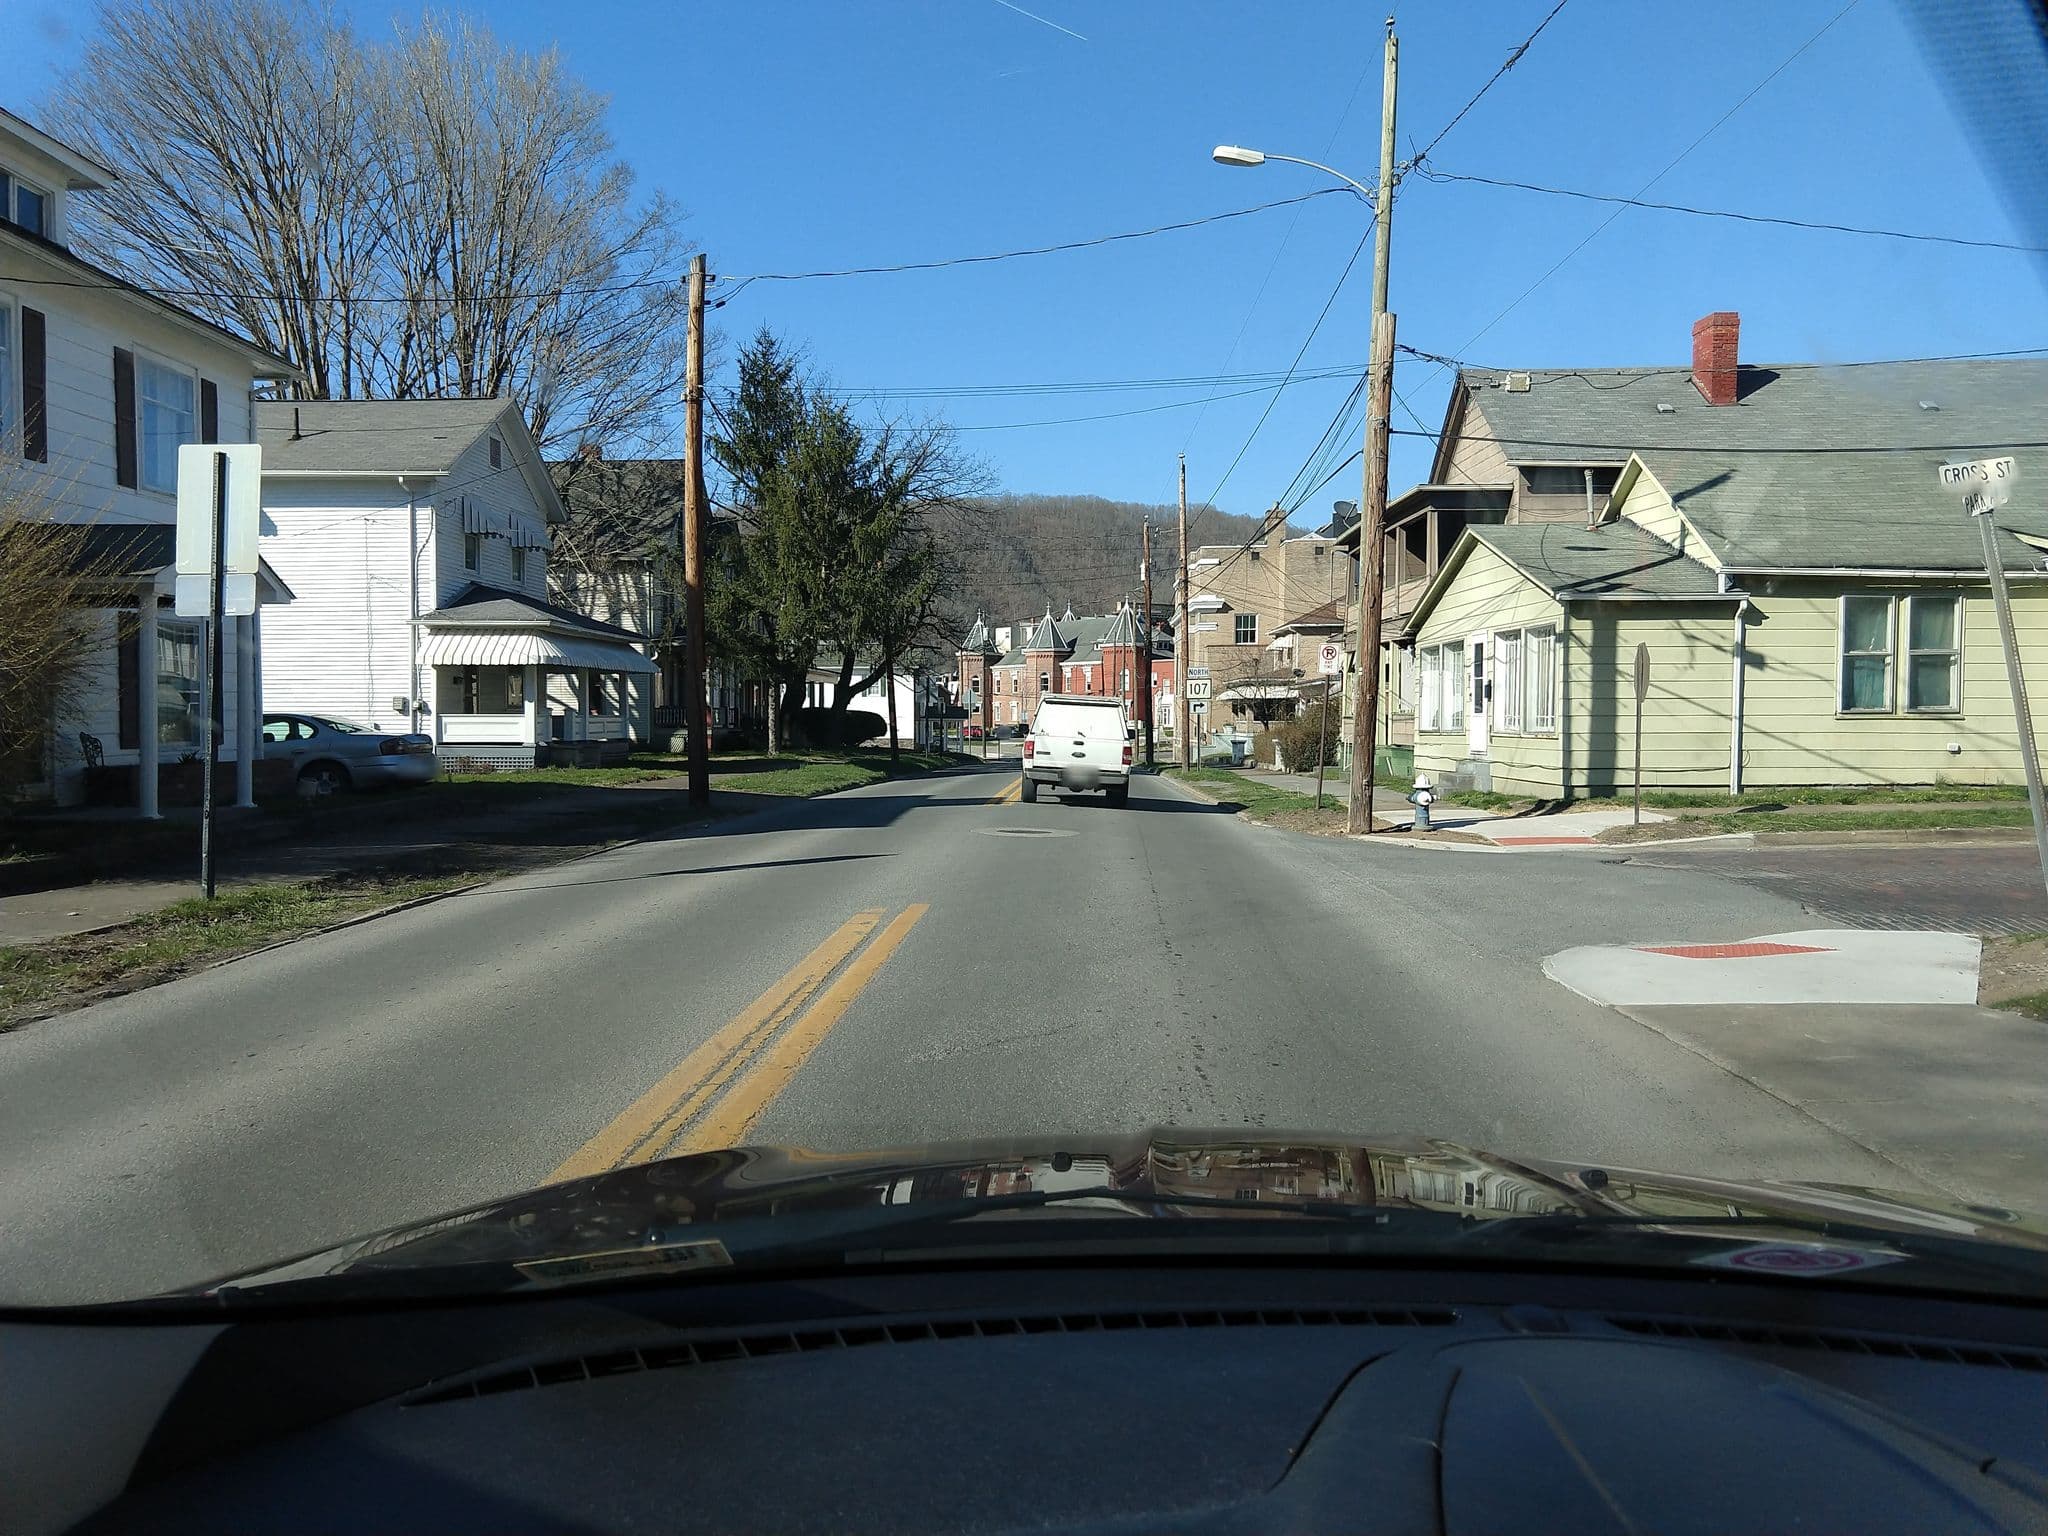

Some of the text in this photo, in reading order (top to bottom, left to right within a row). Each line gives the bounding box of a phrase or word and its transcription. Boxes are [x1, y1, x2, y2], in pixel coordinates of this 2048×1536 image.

[1944, 461, 2011, 484] CROSS ST
[1188, 668, 1209, 676] NORTH
[1189, 682, 1208, 695] 107
